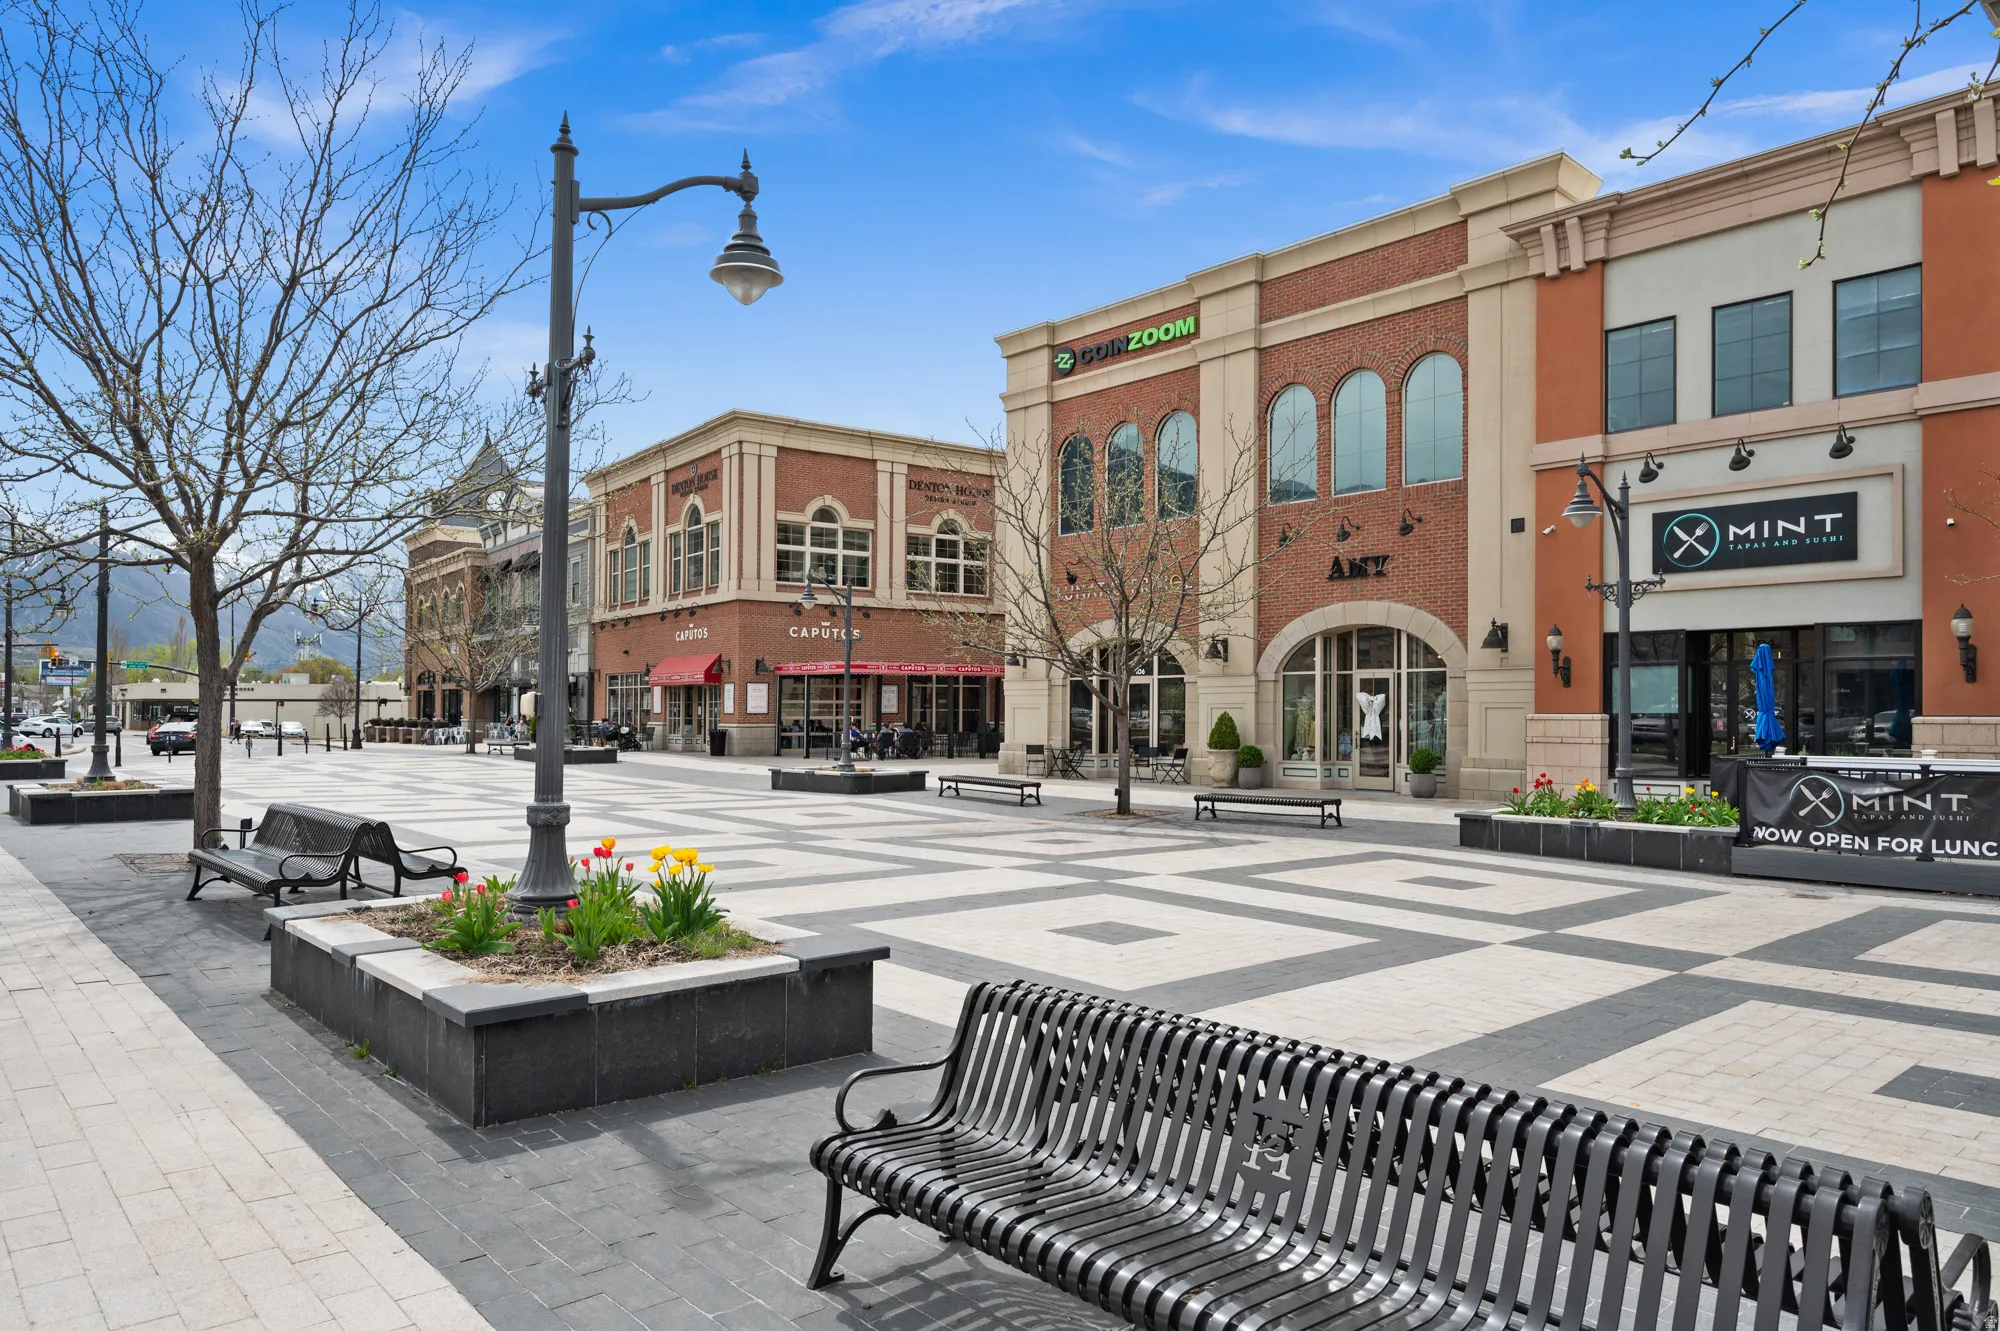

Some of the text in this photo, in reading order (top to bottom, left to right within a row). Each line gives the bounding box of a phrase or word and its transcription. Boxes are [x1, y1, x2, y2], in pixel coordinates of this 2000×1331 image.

[1077, 315, 1197, 365] COINZOOM
[909, 479, 953, 494] DENTON
[1729, 512, 1843, 541] MINT
[1729, 535, 1844, 551] TAPAS AND SUSHI
[1326, 554, 1390, 579] AMY
[675, 627, 708, 641] CAPUTO'S
[1852, 793, 1968, 812] MINT
[1932, 814, 1970, 822] SUSHI
[1753, 826, 1803, 843] NOW
[1809, 831, 1869, 850] OPEN
[1877, 836, 1923, 853] FOR
